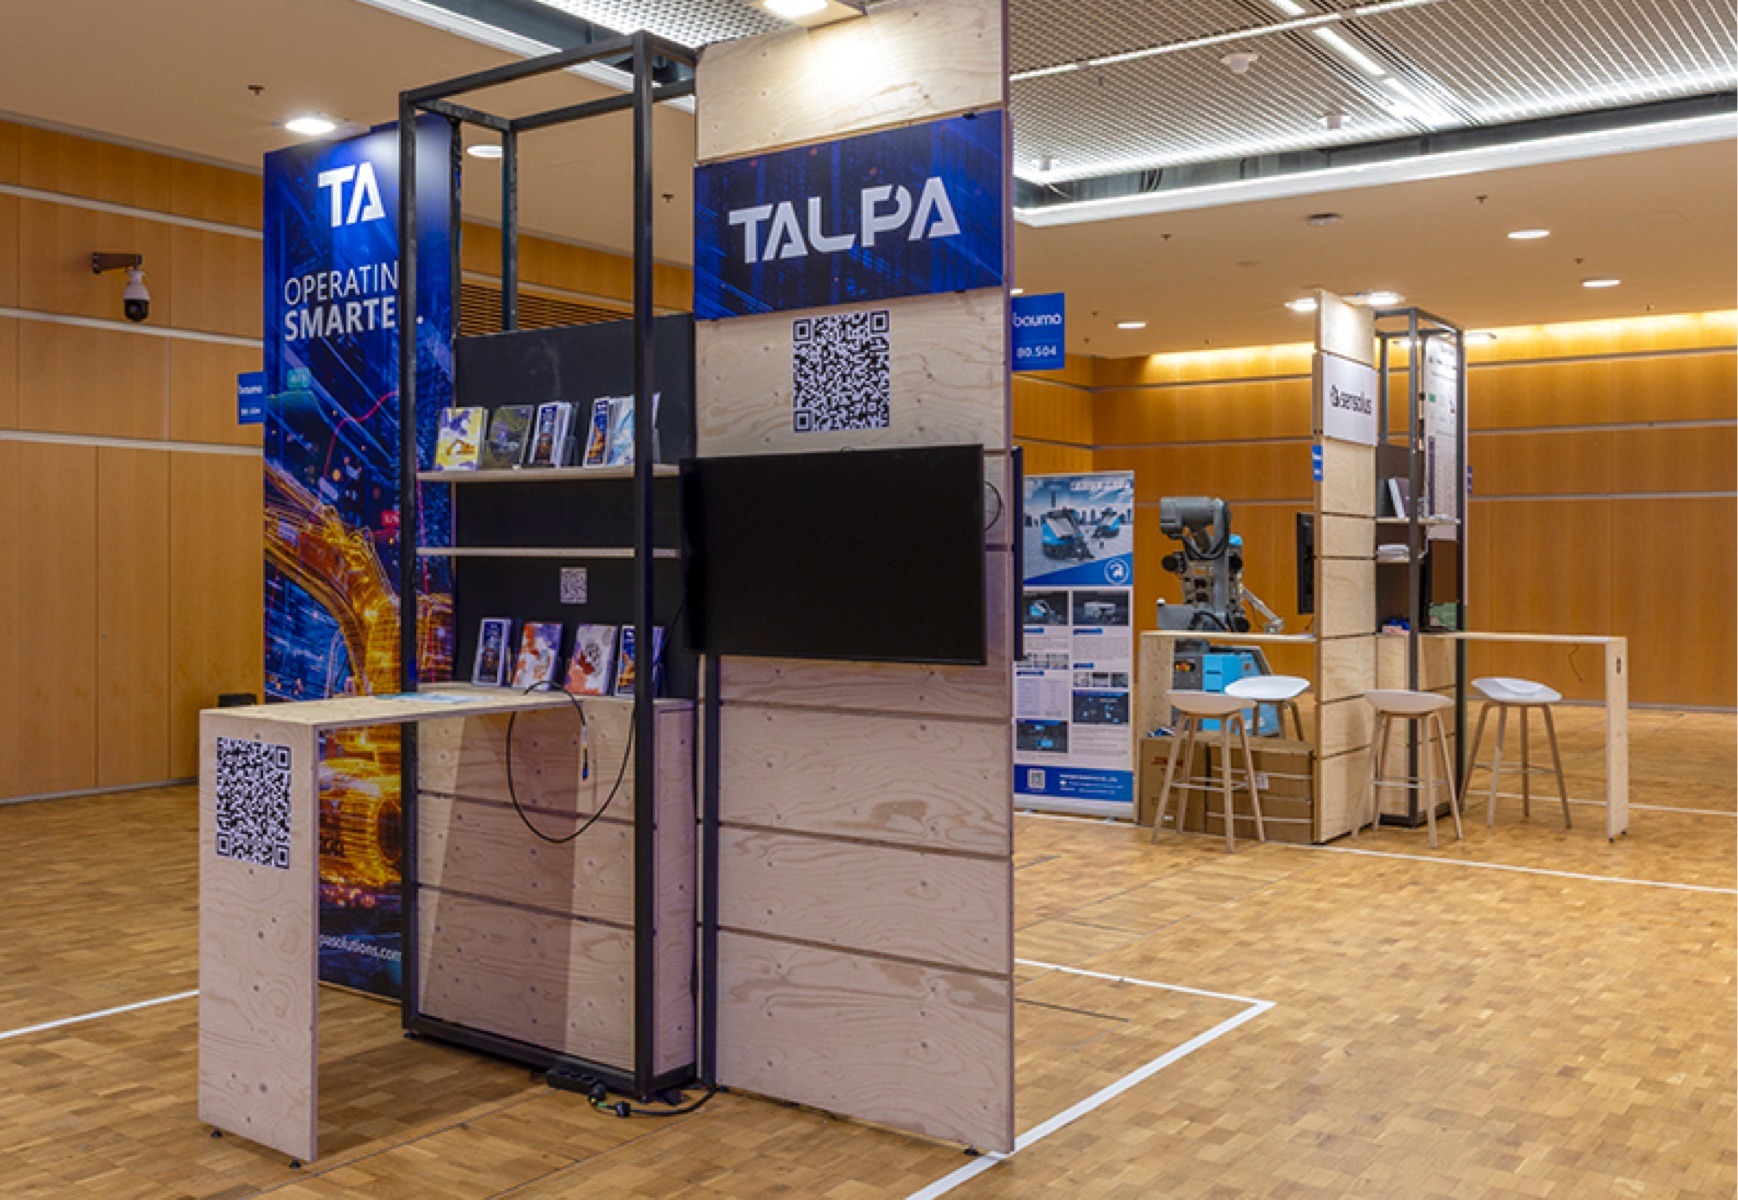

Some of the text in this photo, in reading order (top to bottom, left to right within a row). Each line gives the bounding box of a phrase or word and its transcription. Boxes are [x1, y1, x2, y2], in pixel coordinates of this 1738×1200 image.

[317, 161, 386, 228] TA
[728, 176, 961, 264] TALPA
[284, 259, 399, 306] OPERATIN
[284, 295, 424, 342] SMARTE.
[1012, 312, 1062, 328] bauma
